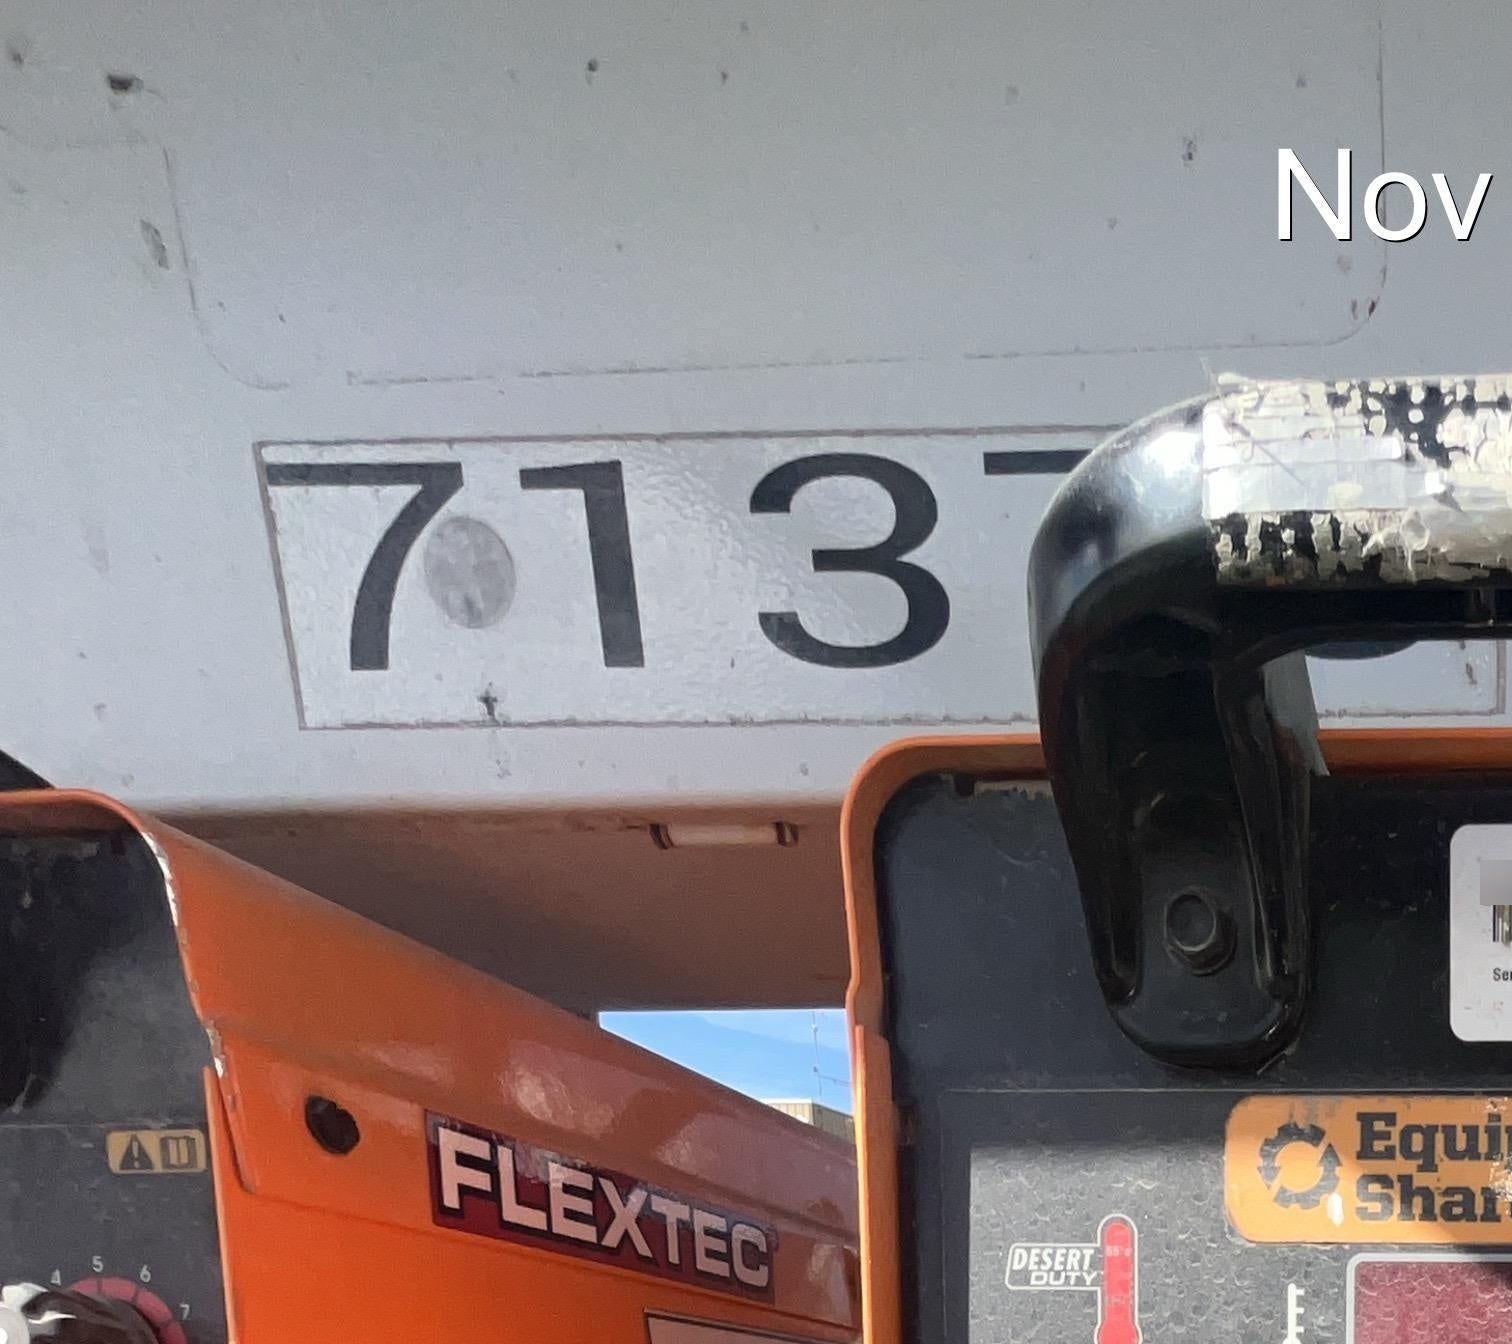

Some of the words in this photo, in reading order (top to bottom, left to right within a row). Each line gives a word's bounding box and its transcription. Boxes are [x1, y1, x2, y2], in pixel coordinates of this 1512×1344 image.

[264, 450, 1090, 672] 713
[438, 1126, 770, 1288] FLEXTEC
[92, 1256, 103, 1272] 5
[1012, 1248, 1095, 1271] DESERT
[50, 1269, 62, 1286] 4
[139, 1265, 151, 1283] 6
[1030, 1270, 1098, 1286] DUTY
[180, 1303, 190, 1319] 7
